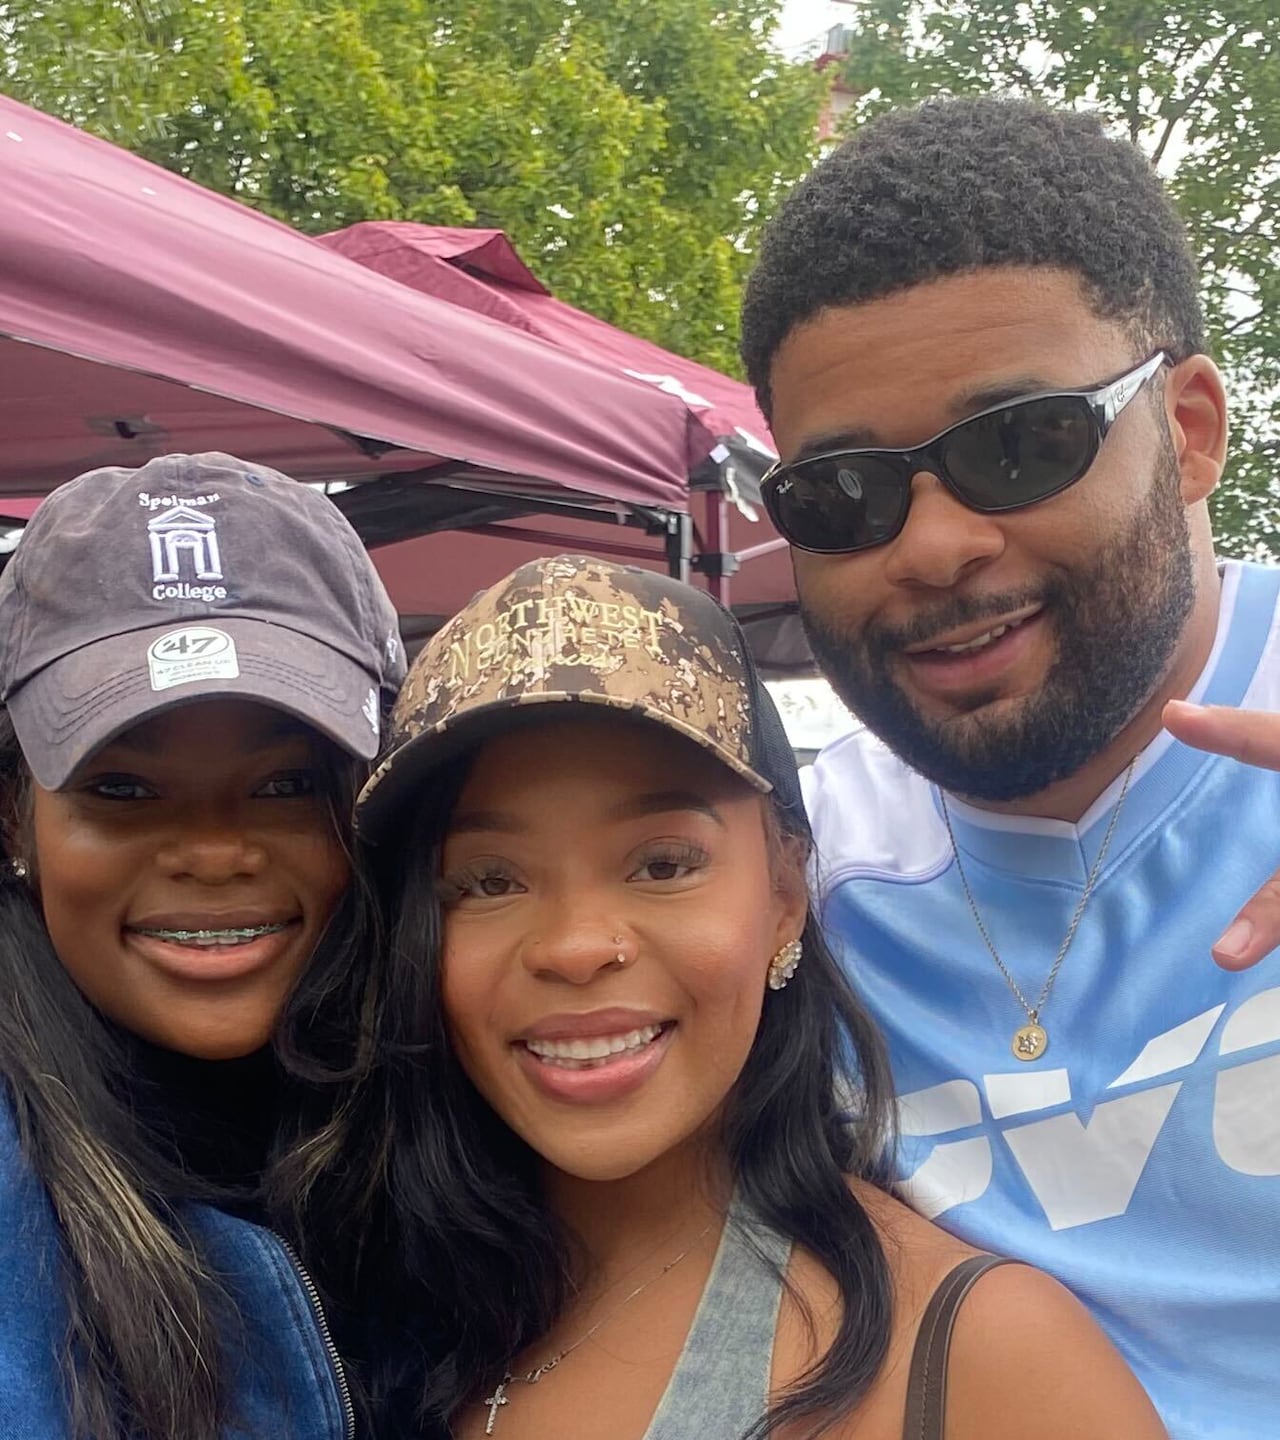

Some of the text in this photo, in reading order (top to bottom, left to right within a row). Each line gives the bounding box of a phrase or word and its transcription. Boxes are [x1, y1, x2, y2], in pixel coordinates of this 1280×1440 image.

[138, 491, 221, 511] Spelman
[152, 583, 227, 601] College
[445, 595, 664, 688] NORTHWEST
